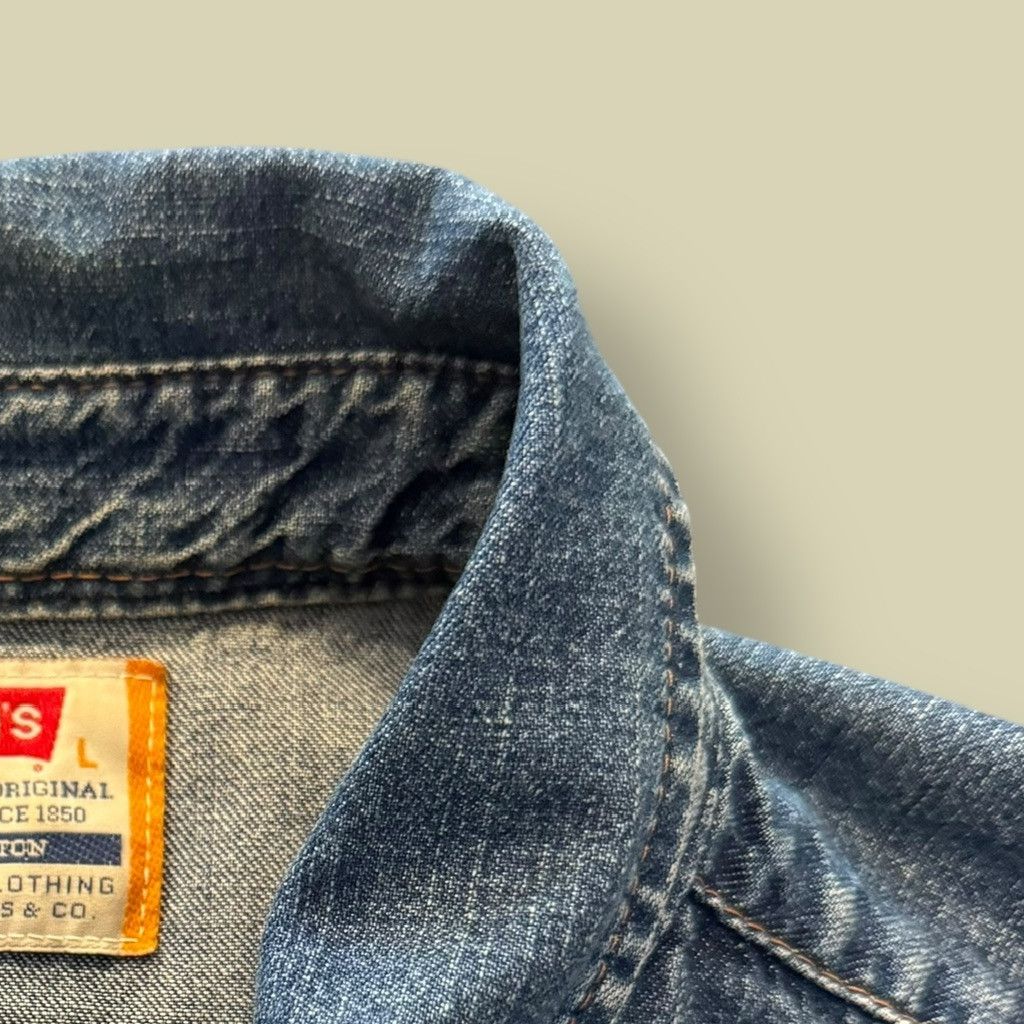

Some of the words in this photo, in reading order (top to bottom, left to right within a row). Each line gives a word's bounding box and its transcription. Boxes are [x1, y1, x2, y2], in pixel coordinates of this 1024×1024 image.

[78, 737, 98, 768] L
[36, 806, 86, 822] 1850
[24, 903, 39, 917] &
[52, 903, 96, 919] CO.
